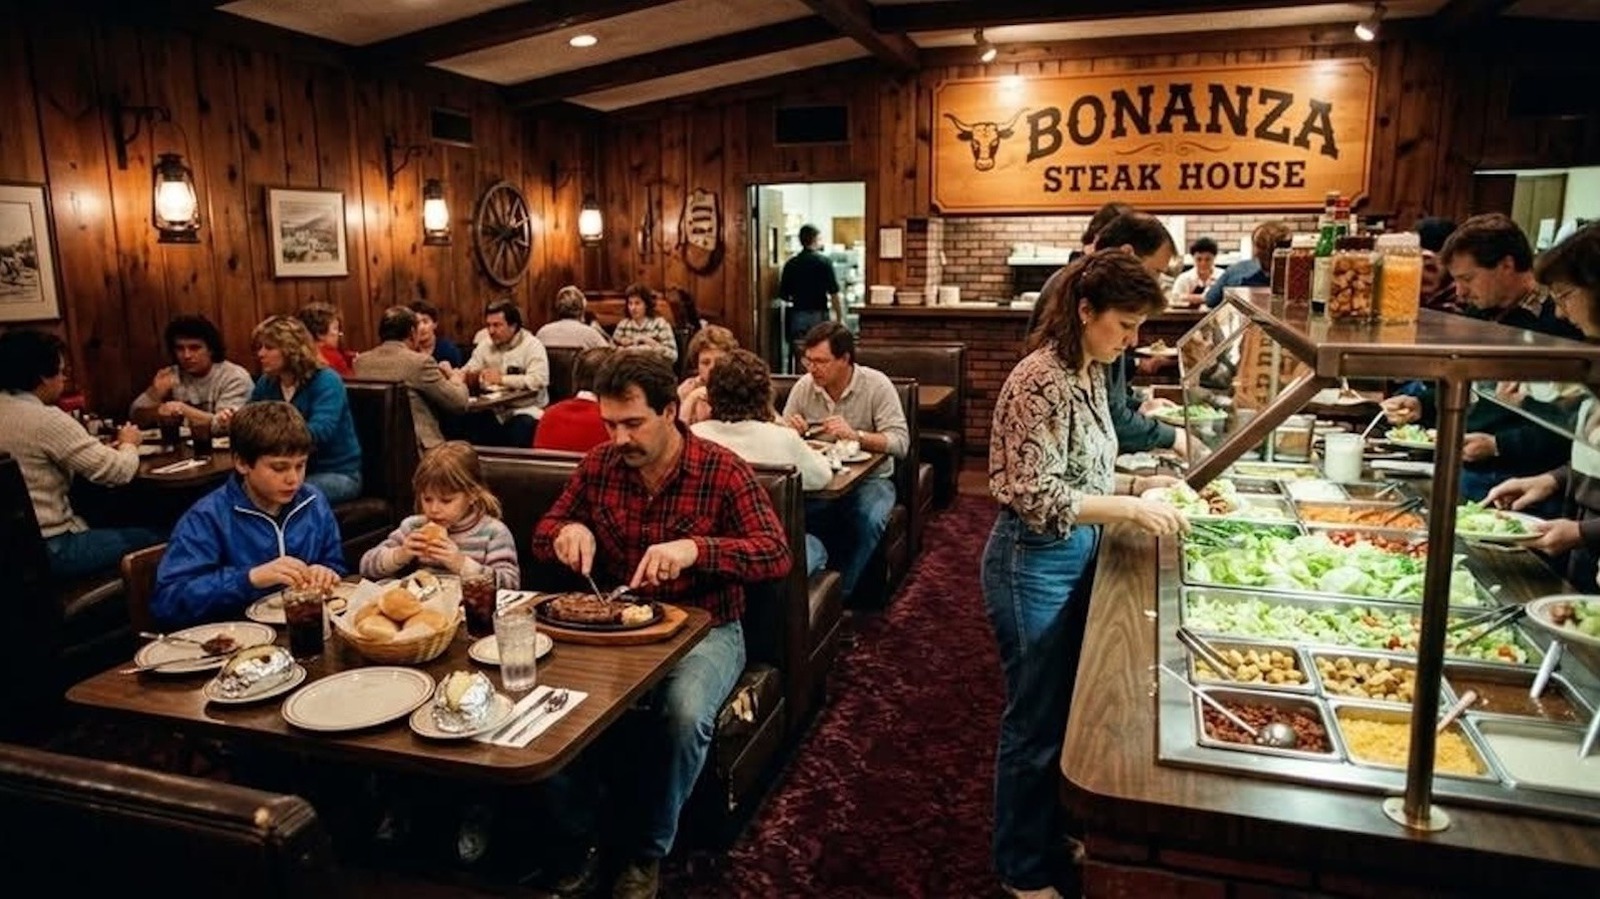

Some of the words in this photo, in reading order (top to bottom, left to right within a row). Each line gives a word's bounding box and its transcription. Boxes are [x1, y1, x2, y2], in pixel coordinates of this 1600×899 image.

[1026, 83, 1339, 162] BONANZA
[1043, 165, 1162, 193] STEAK
[1179, 161, 1306, 191] HOUSE
